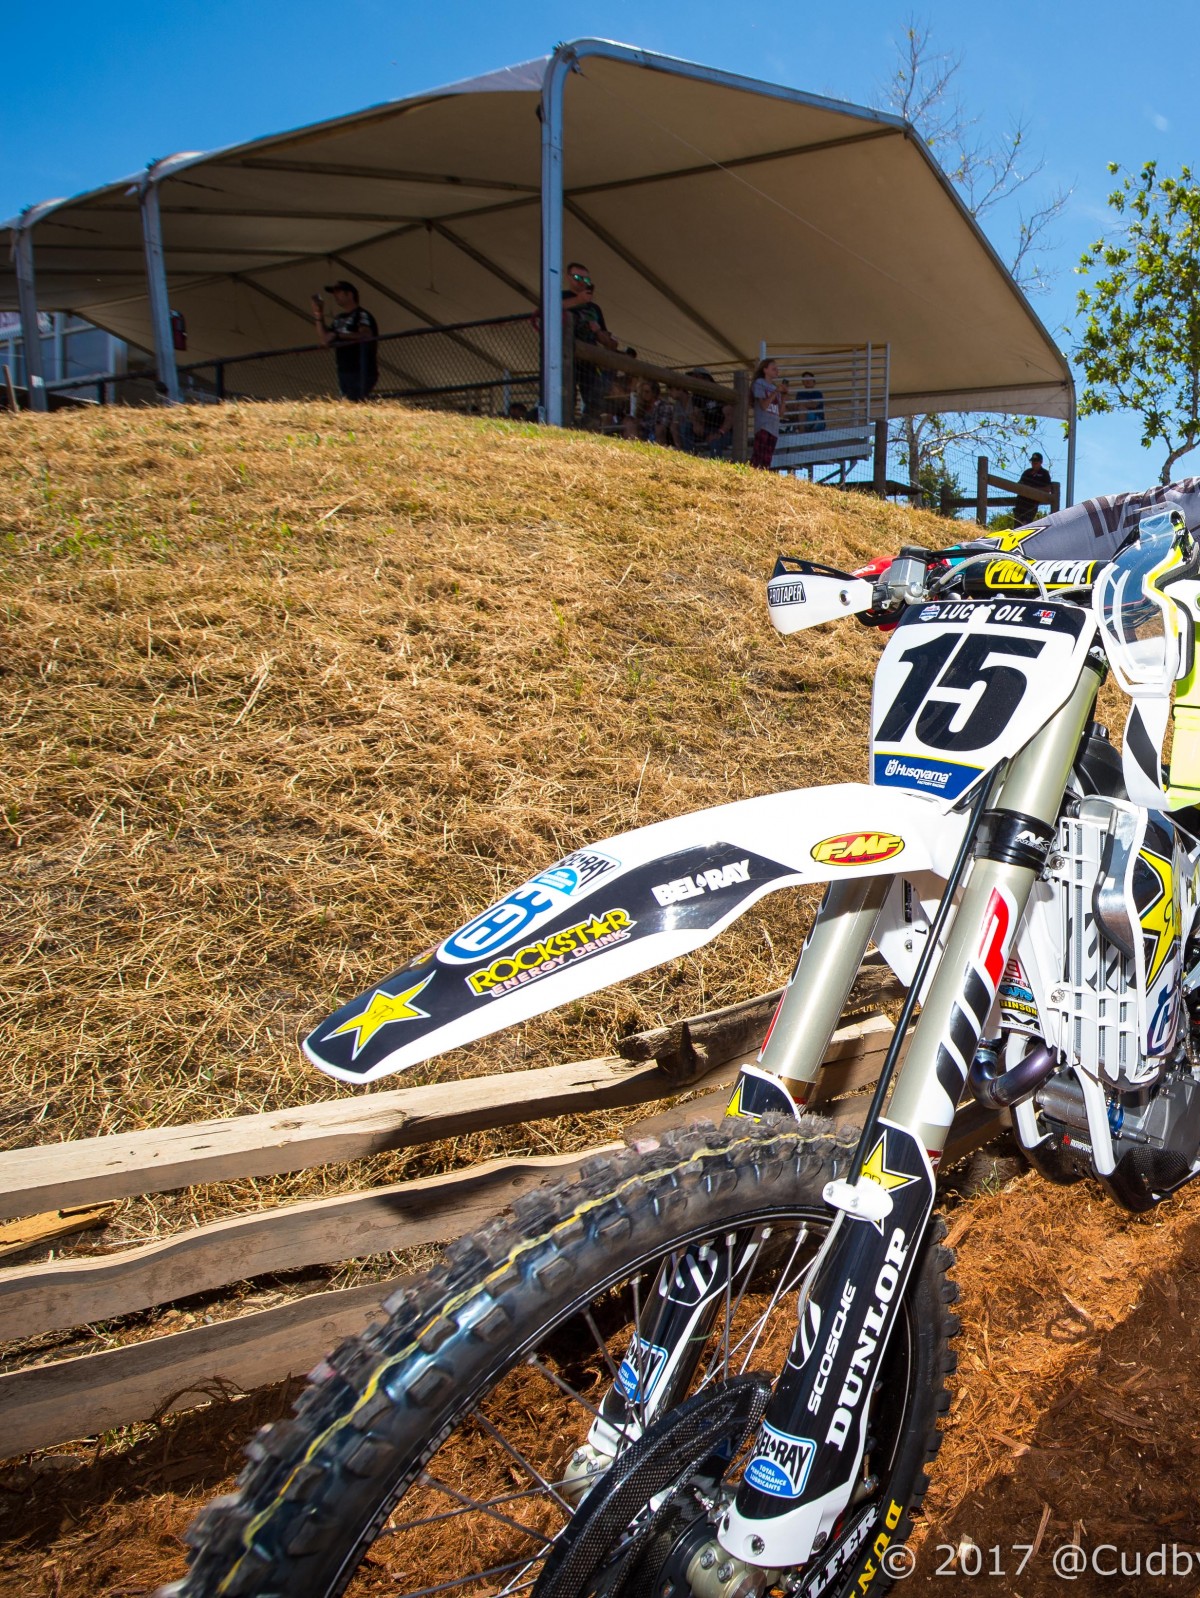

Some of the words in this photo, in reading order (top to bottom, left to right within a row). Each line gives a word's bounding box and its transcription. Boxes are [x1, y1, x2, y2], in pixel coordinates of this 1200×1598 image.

[994, 604, 1027, 622] OIL
[874, 631, 1047, 753] 15
[895, 763, 949, 783] Husqvarna
[814, 835, 903, 862] FMF
[492, 953, 566, 995] ENERGY
[573, 929, 627, 958] DRINK
[807, 1278, 857, 1416] SCOSCHE
[825, 1227, 908, 1452] DUNLOP
[749, 1474, 781, 1492] LUBRICANTS
[750, 1465, 788, 1487] PERFORMANCE
[759, 1464, 776, 1476] TOTAL
[849, 1499, 903, 1598] DUN
